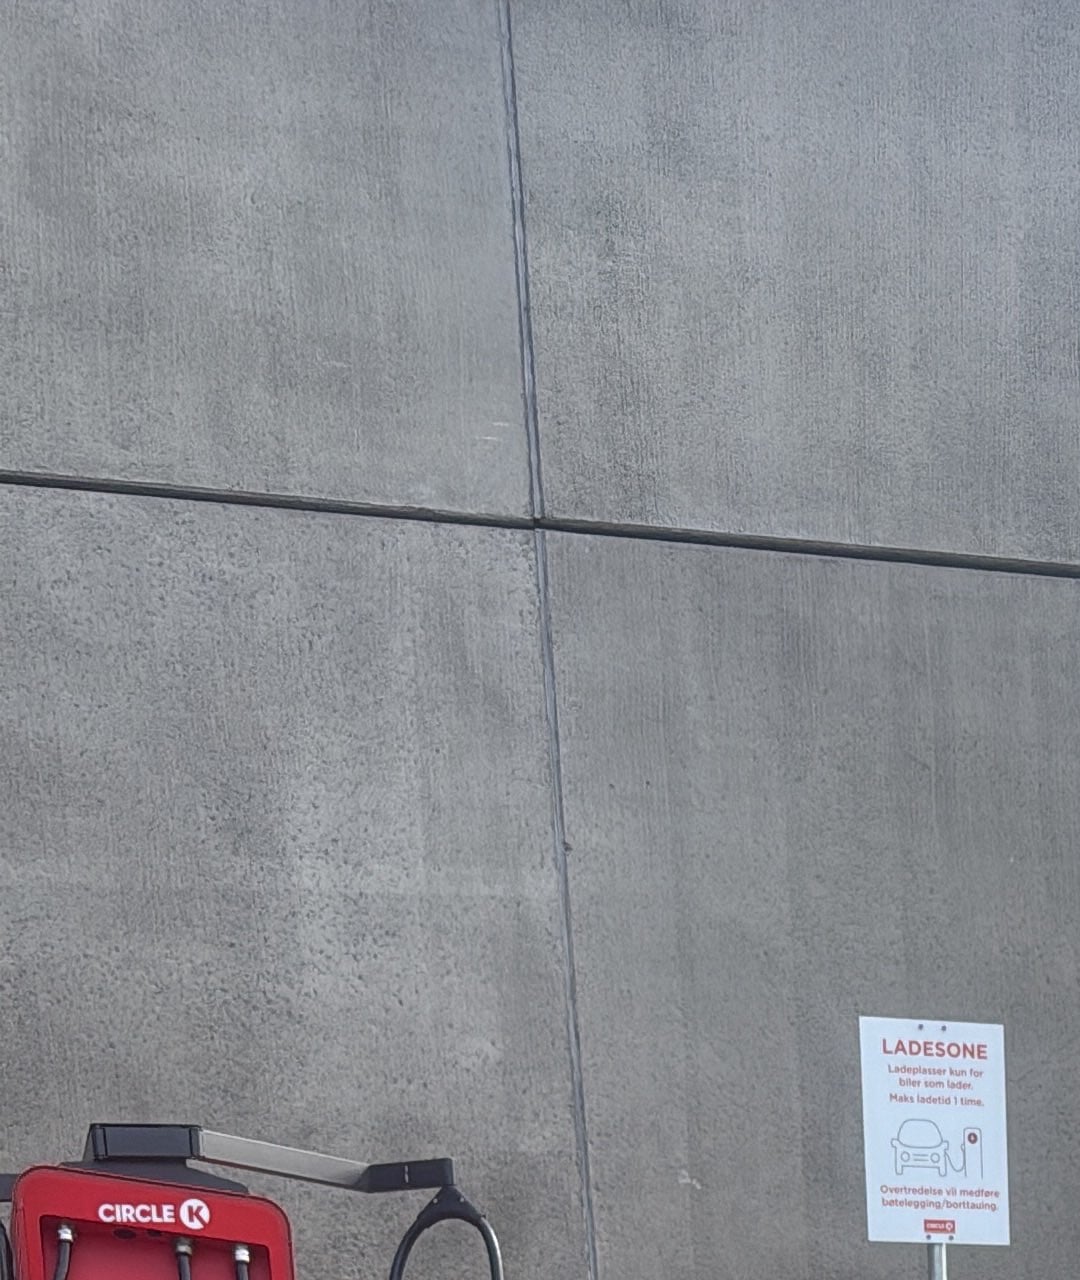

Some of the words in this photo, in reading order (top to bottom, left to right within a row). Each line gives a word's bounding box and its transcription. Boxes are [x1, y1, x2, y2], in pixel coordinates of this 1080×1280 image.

[882, 1038, 988, 1060] LADESONE
[887, 1064, 947, 1076] Ladeplasser
[949, 1067, 967, 1077] kun
[970, 1068, 984, 1078] for
[898, 1077, 922, 1088] biler
[889, 1092, 914, 1103] Maks
[916, 1093, 951, 1105] ladetid
[953, 1096, 958, 1106] 1
[880, 1184, 943, 1196] Overtredelse
[945, 1186, 957, 1196] vil
[959, 1187, 1000, 1198] medføre
[98, 1203, 176, 1223] CIRCLE
[182, 1201, 210, 1229] K
